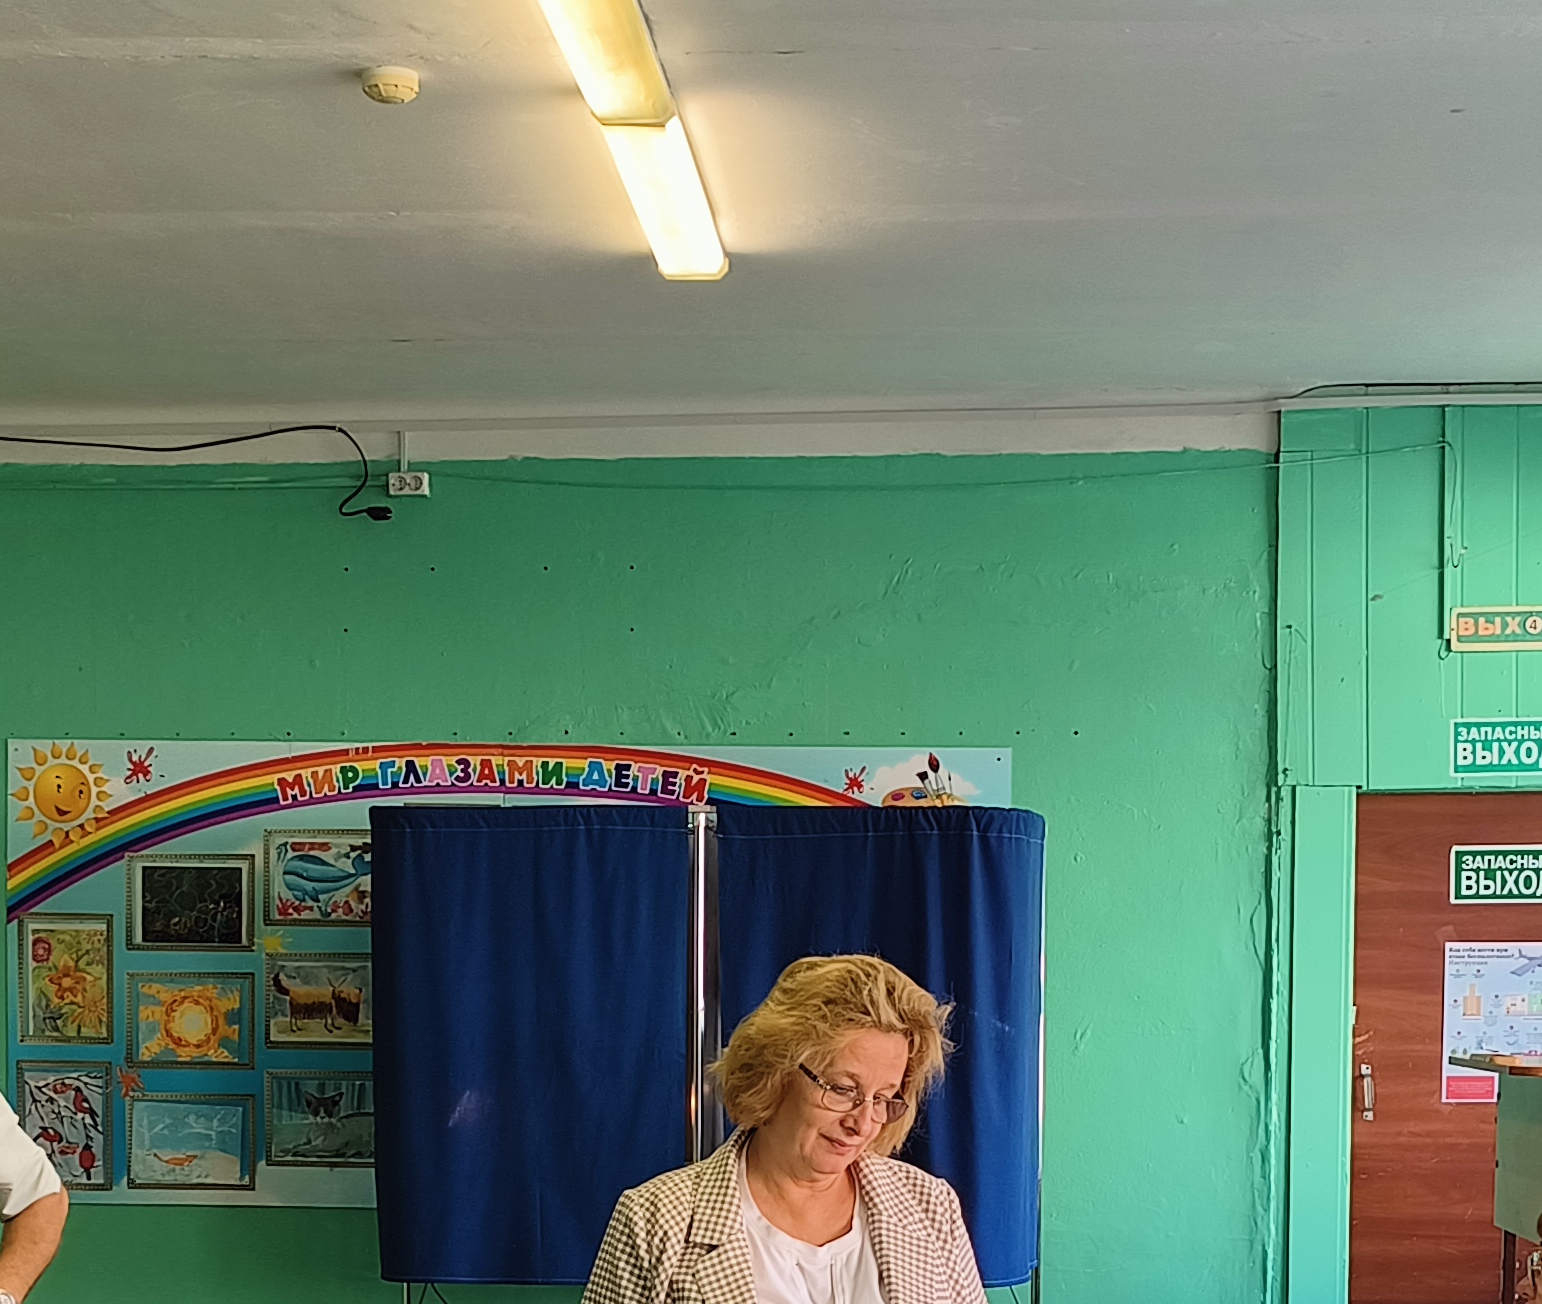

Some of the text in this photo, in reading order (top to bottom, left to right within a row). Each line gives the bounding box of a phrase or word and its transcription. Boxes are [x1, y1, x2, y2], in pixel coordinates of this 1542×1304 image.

[277, 757, 711, 806] МИР ГЛАЗАМИ ДЕТЕЙ
